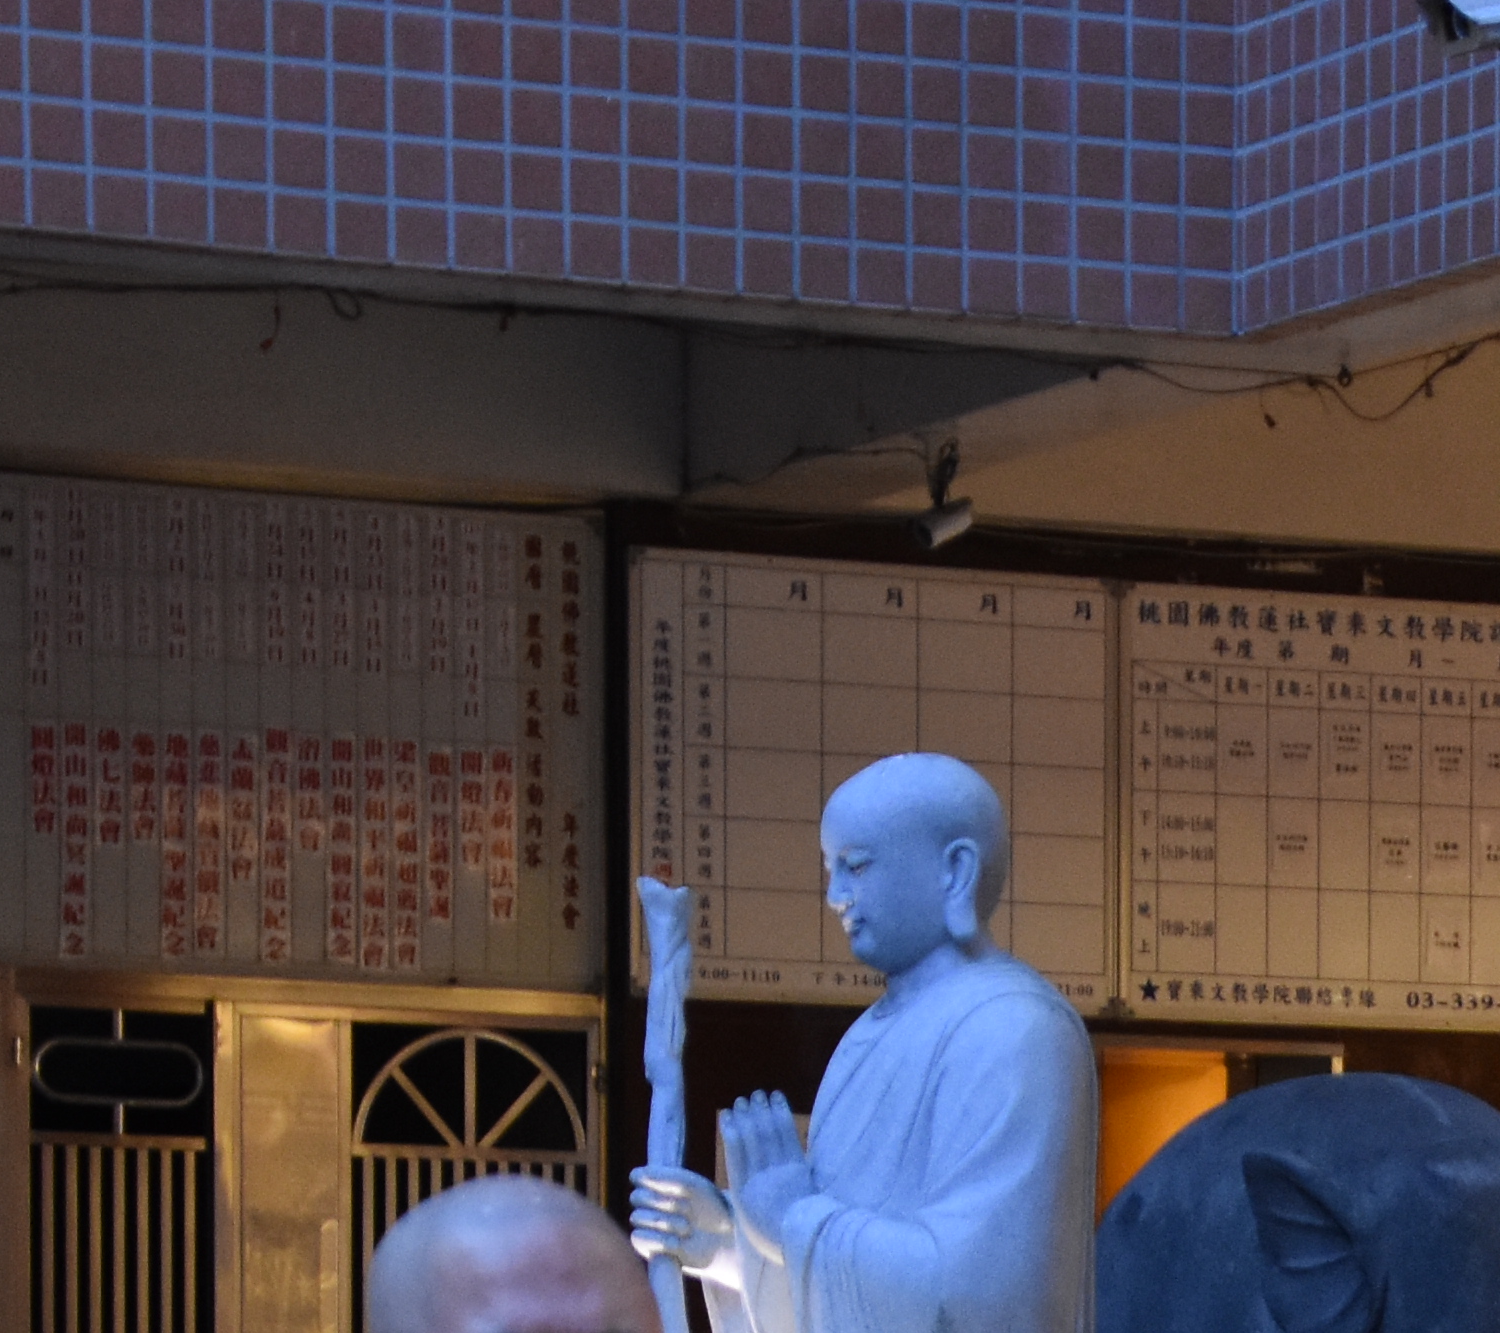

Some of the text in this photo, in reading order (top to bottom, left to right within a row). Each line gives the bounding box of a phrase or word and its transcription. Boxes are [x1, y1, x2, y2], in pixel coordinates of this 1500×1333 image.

[788, 580, 808, 602] 月
[885, 587, 904, 609] 月
[980, 593, 998, 615] 月
[1073, 600, 1092, 621] 月
[1212, 635, 1254, 661] 年度
[1278, 640, 1295, 662] 第
[1330, 643, 1350, 666] 期
[1407, 649, 1424, 669] 月
[1224, 675, 1263, 695] 星期一
[1275, 678, 1315, 698] 星期二
[1327, 681, 1367, 700] 星期三
[1378, 685, 1418, 704] 星期四
[1429, 688, 1467, 707] 星期五
